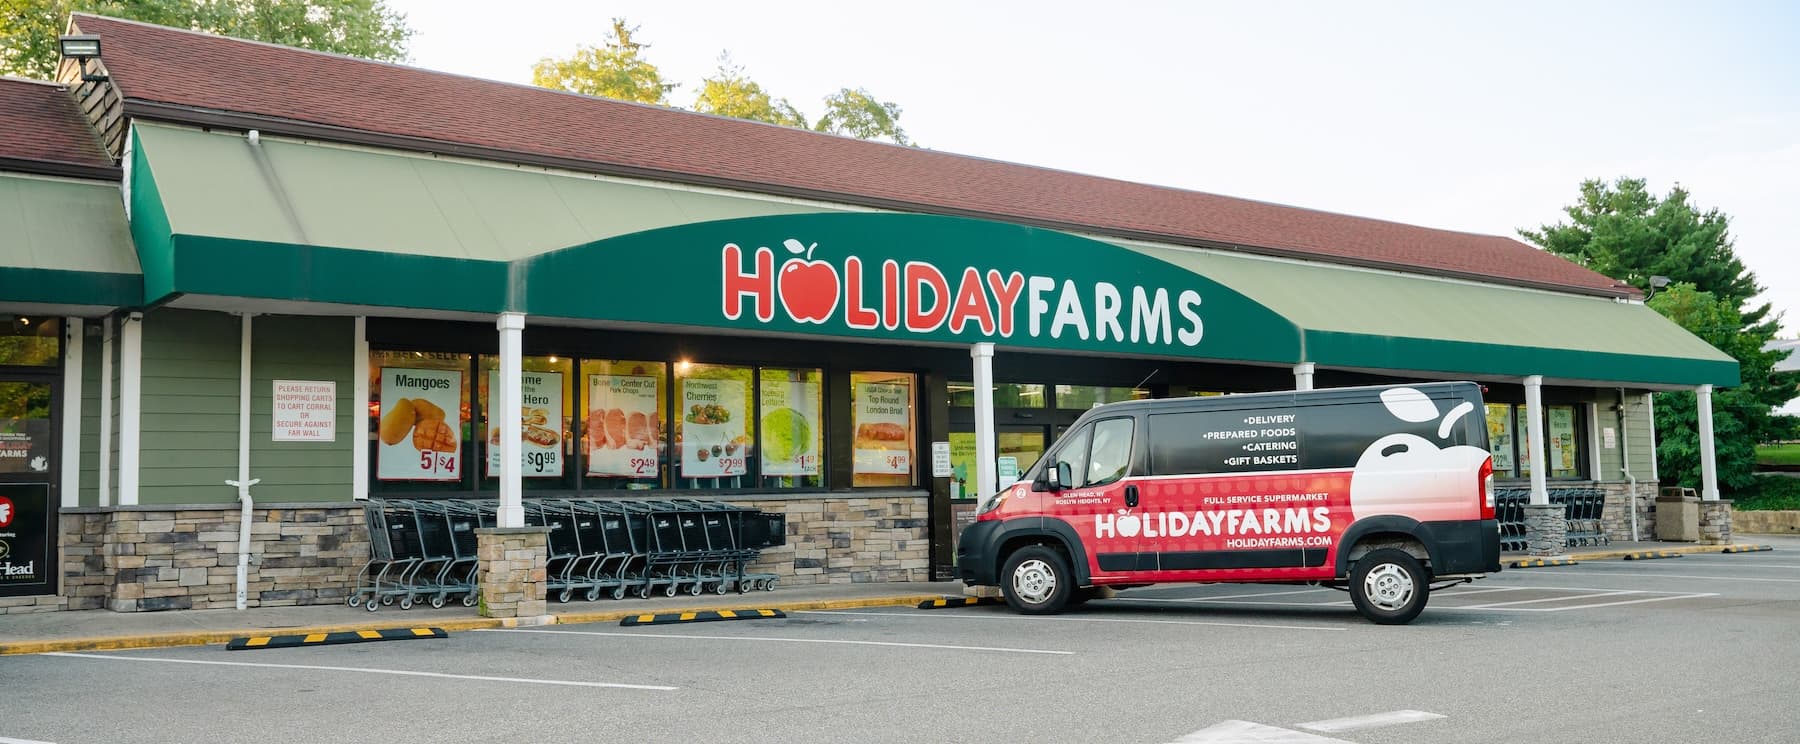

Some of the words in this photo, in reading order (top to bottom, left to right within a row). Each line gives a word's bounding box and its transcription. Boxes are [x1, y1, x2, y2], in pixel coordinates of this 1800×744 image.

[395, 374, 450, 391] Mangoes
[521, 376, 542, 385] me
[620, 379, 643, 388] Center
[278, 385, 303, 393] PLEASE
[276, 394, 311, 402] SHOPPING
[523, 394, 549, 405] Hero
[686, 391, 718, 402] Cherries
[868, 395, 880, 405] Top
[277, 402, 286, 410] TO
[287, 402, 304, 410] CART
[866, 405, 889, 414] London
[276, 420, 303, 428] SECURE
[303, 420, 332, 428] AGAINST
[287, 429, 301, 437] FAR
[1260, 428, 1296, 438] FOODS
[1253, 455, 1298, 465] BASKETS
[1204, 496, 1225, 505] FULL
[1226, 495, 1262, 504] SERVICE
[1264, 493, 1329, 503] SUPERMARKET
[1226, 536, 1332, 549] HOLIDAYFARMS.COM
